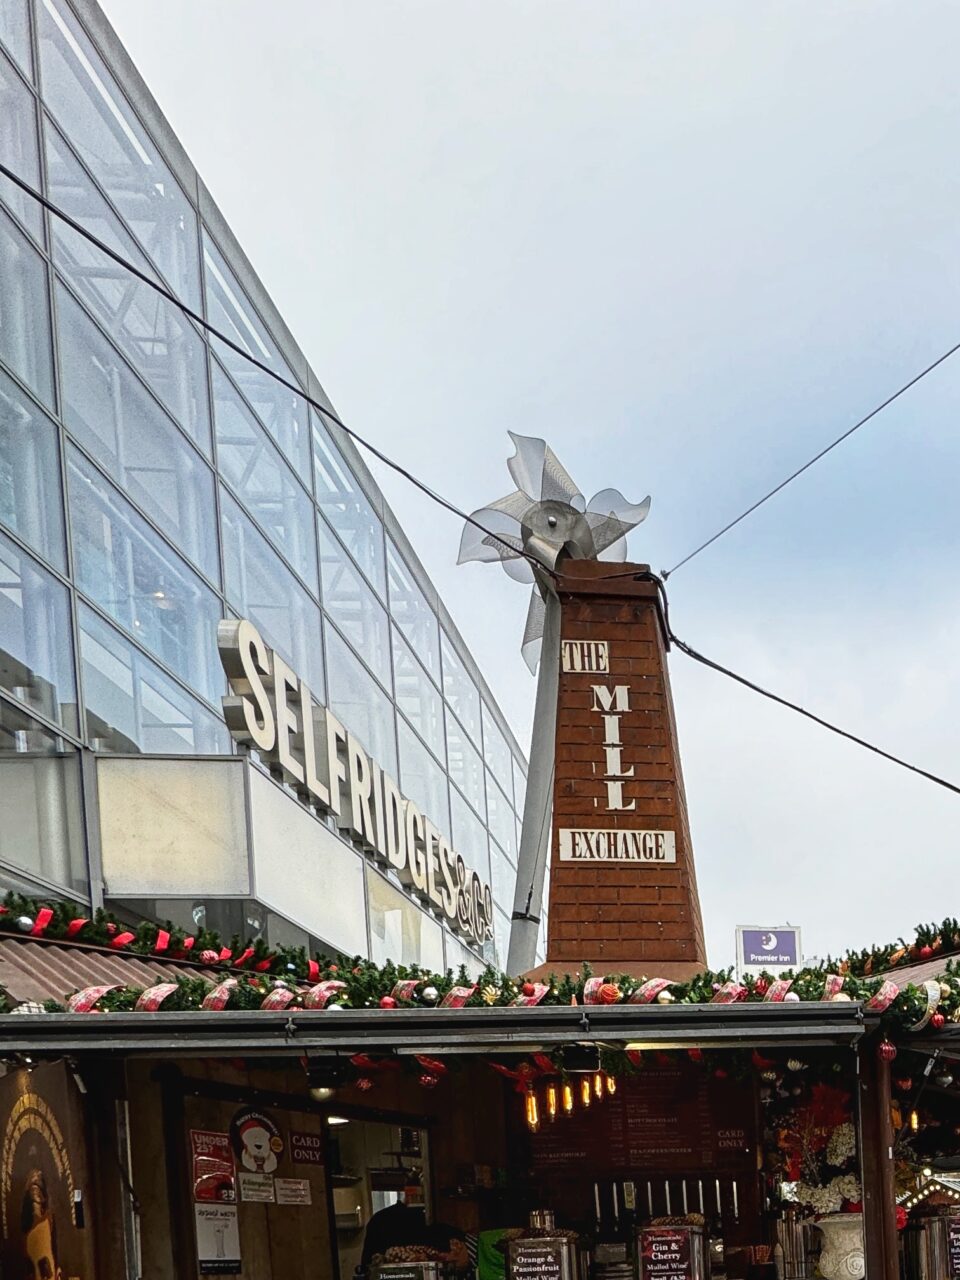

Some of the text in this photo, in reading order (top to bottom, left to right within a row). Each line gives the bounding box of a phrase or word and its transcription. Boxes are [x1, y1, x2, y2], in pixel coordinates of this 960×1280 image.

[563, 642, 606, 671] THE
[590, 685, 635, 810] MILL
[570, 831, 665, 860] EXCHANGE
[750, 954, 790, 962] Premier Inn
[194, 1134, 229, 1146] UNDER
[292, 1136, 320, 1147] CARD
[294, 1150, 320, 1161] ONLY
[652, 1243, 668, 1251] Gin
[517, 1256, 545, 1264] Orange
[651, 1252, 680, 1260] Cherry
